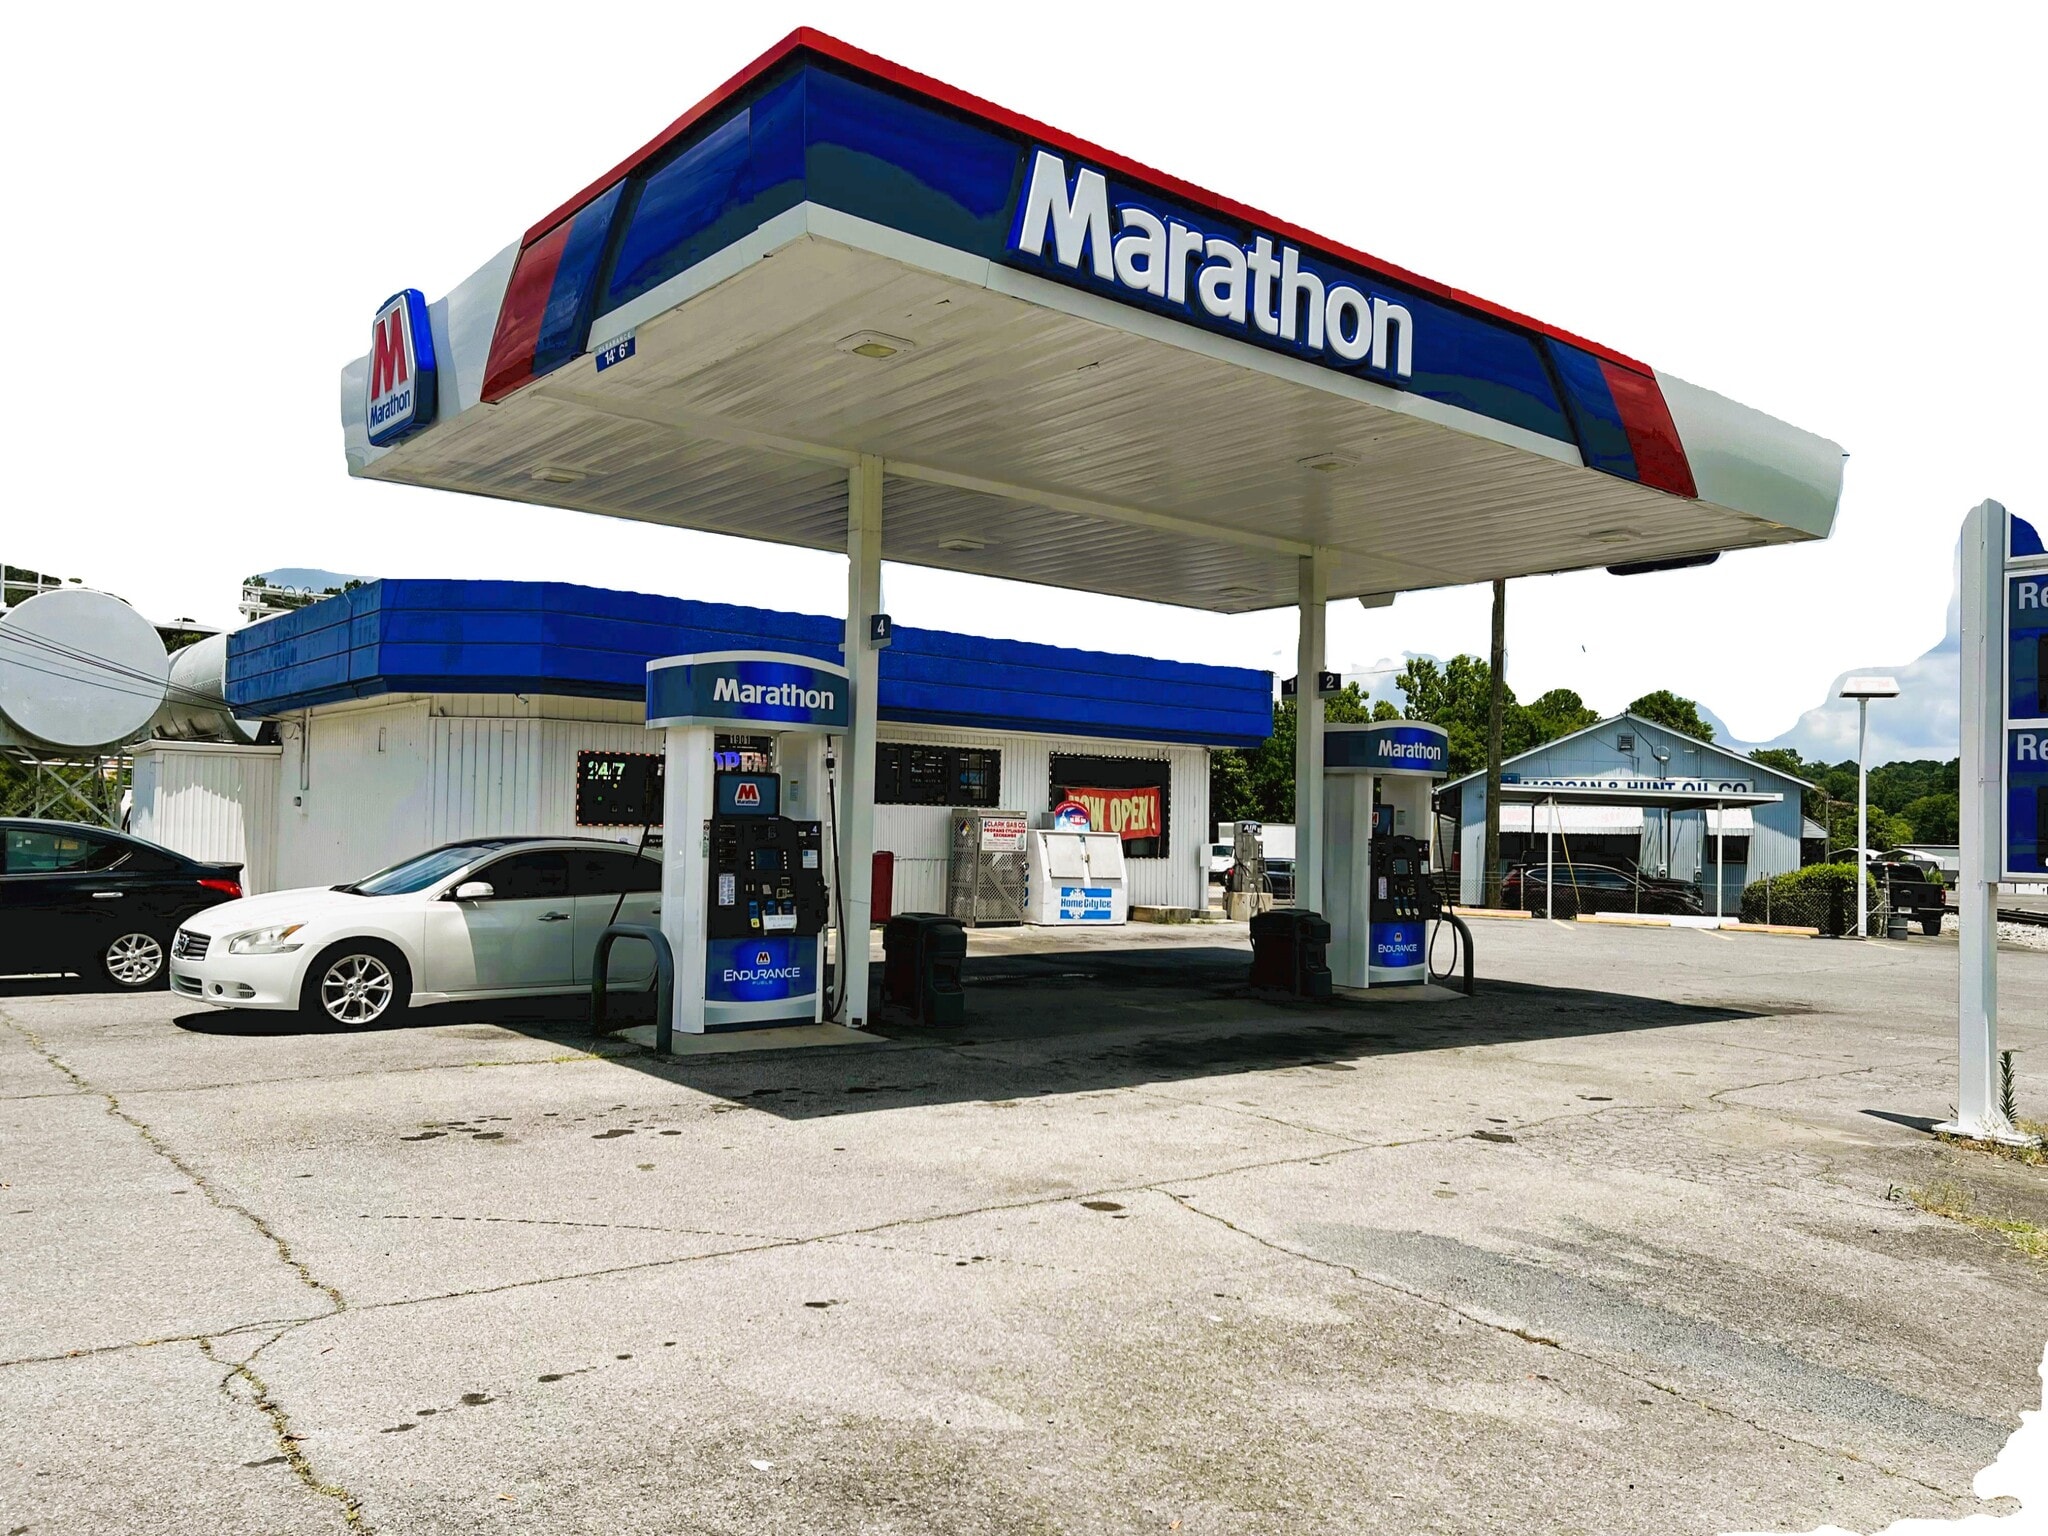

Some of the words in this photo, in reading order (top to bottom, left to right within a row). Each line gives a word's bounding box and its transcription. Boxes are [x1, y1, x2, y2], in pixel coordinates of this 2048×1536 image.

[1019, 151, 1413, 377] Marathon
[369, 390, 411, 429] Marathon
[877, 619, 886, 636] 4
[1289, 680, 1295, 692] 1
[1326, 676, 1335, 689] 2
[713, 677, 835, 711] Marathon
[1378, 739, 1441, 761] Marathon
[812, 825, 818, 833] 4
[1061, 898, 1083, 908] Home
[1084, 898, 1099, 910] City
[1100, 899, 1112, 908] Ice
[1378, 943, 1417, 954] ENDURANCE
[723, 966, 801, 982] ENDURANCE
